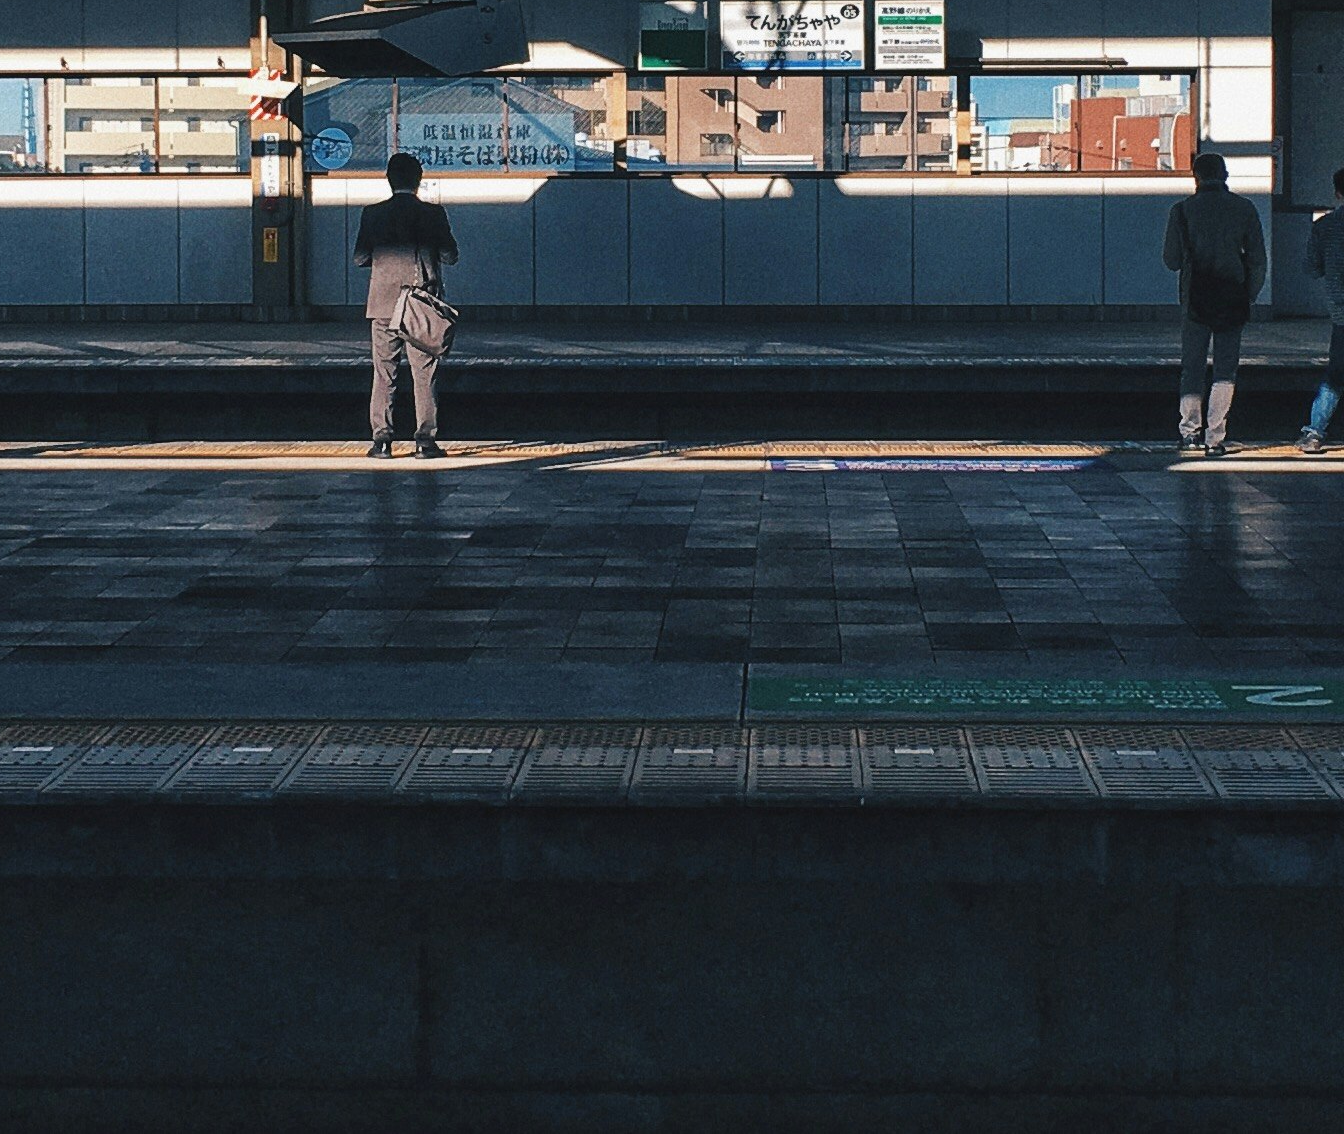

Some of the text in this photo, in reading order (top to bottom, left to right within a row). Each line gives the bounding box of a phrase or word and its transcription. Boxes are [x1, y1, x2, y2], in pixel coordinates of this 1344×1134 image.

[843, 8, 857, 18] 05
[745, 14, 841, 31] てんがちゃや
[763, 39, 823, 48] TENGACHAYA
[1231, 684, 1335, 707] 2
